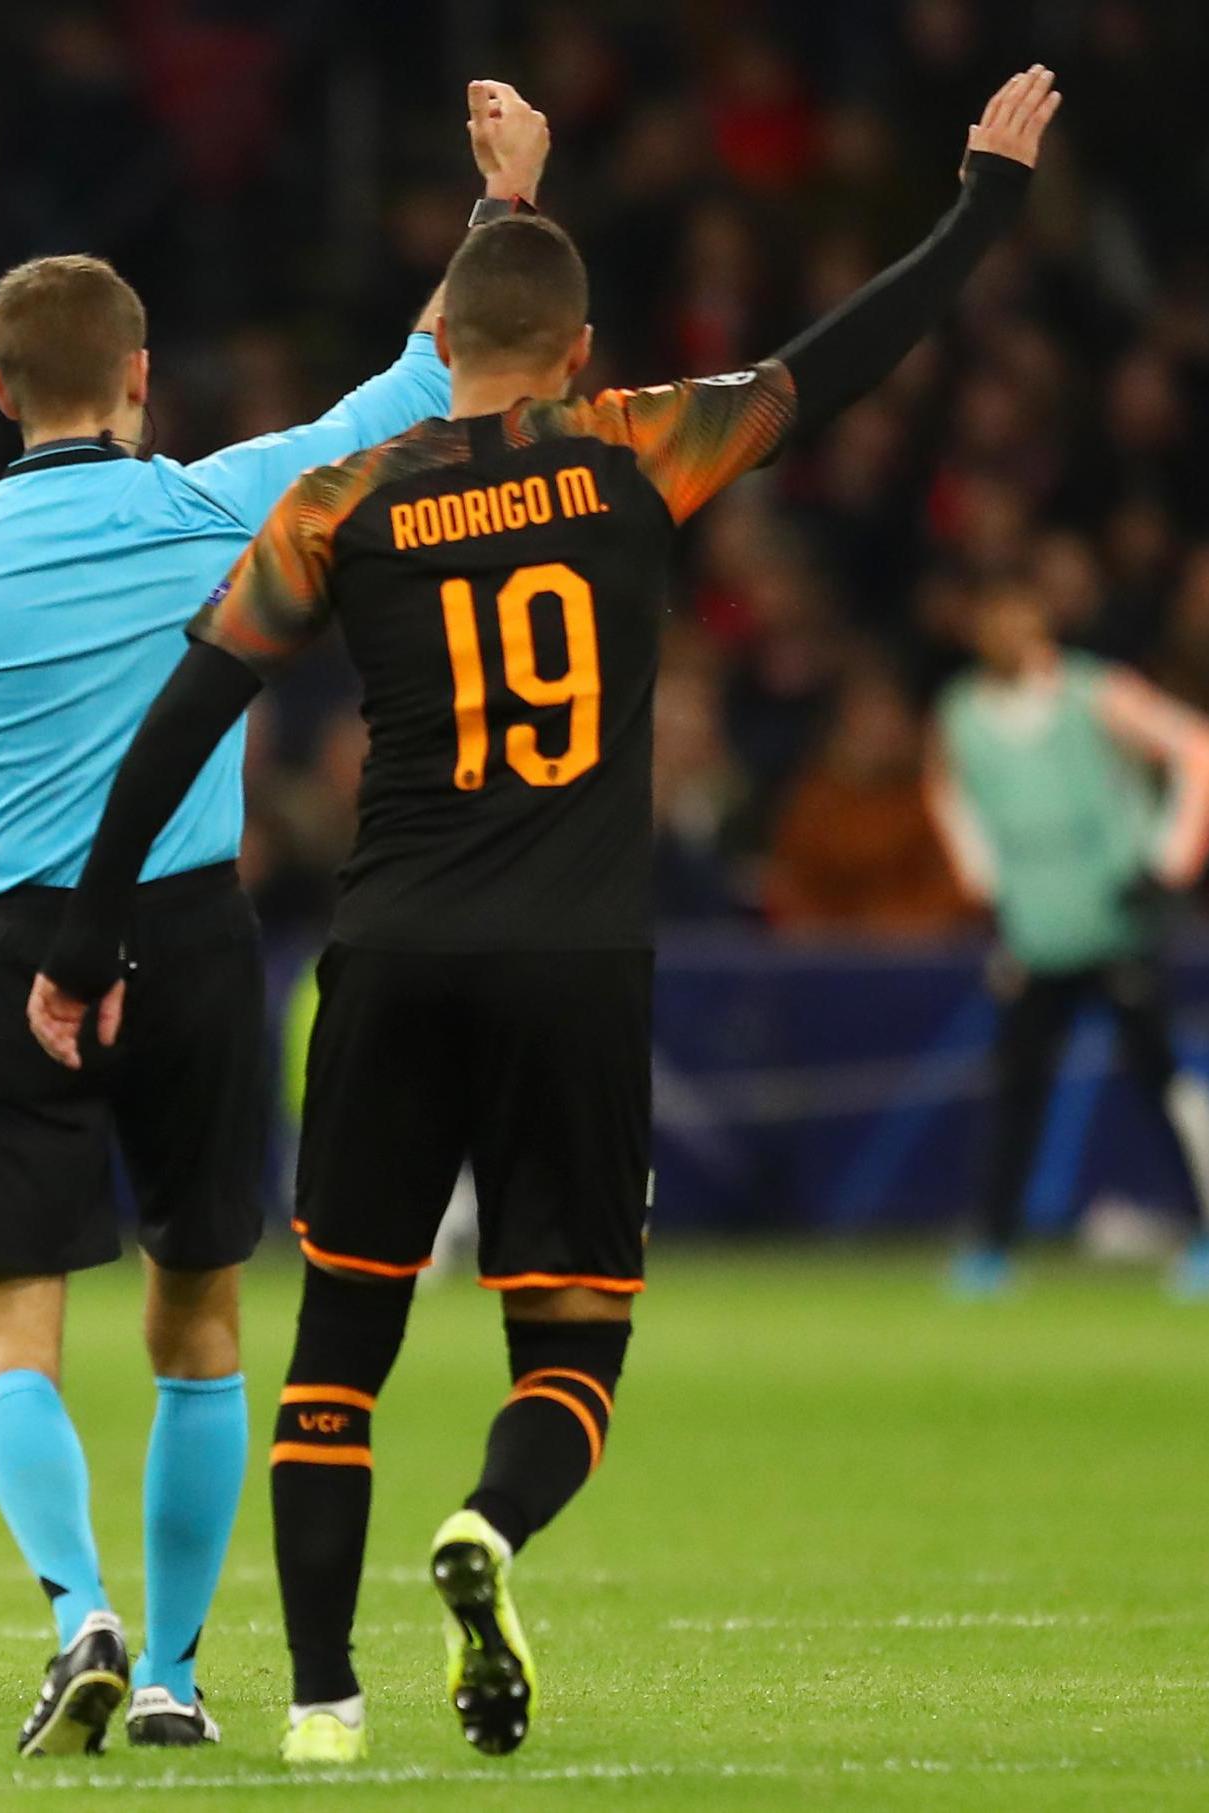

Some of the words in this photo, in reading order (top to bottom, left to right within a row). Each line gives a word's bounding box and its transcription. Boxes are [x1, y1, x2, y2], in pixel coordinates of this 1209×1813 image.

[391, 476, 553, 550] RODRIGO
[555, 466, 610, 518] M.
[440, 562, 601, 791] 19
